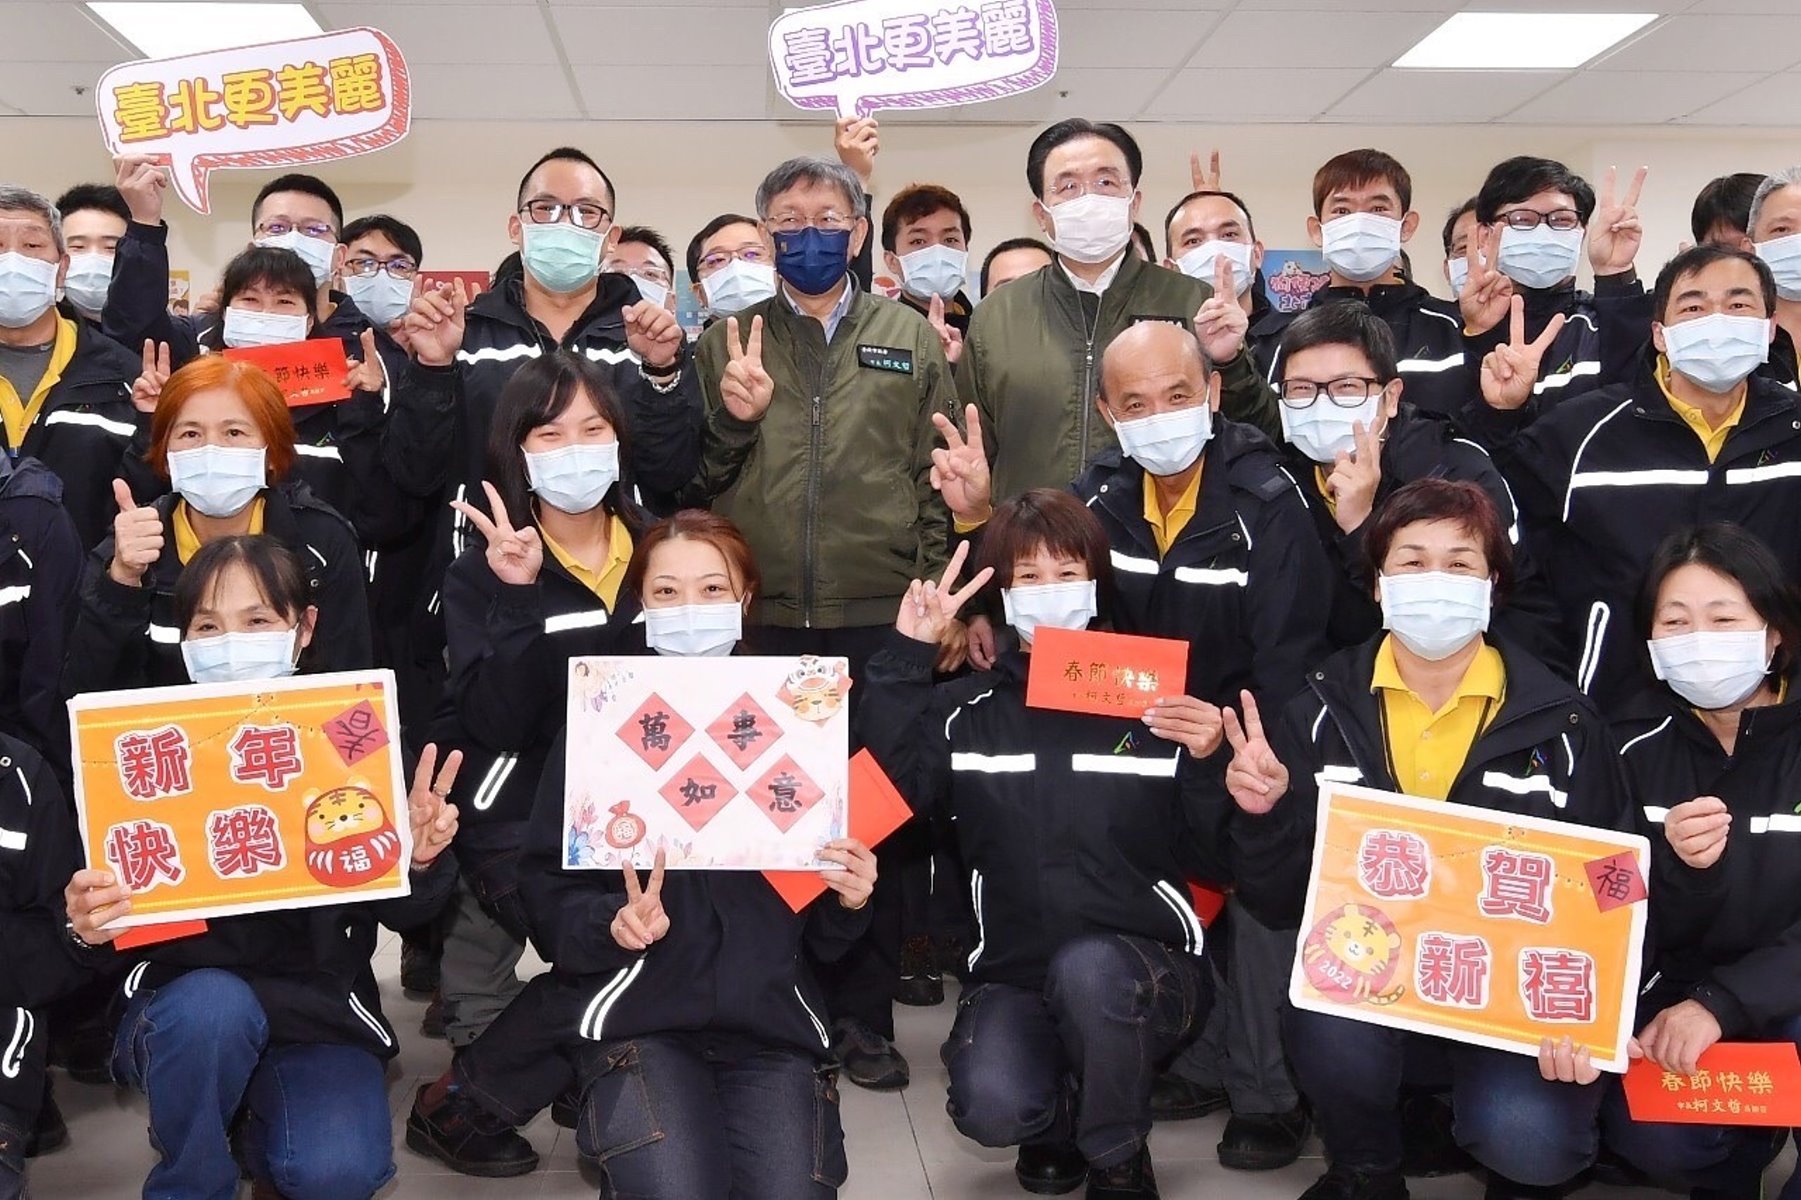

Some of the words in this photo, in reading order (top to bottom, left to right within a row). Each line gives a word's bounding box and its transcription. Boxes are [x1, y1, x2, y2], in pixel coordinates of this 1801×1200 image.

[784, 0, 1035, 87] 臺北更美麗
[113, 53, 386, 144] 臺北更美麗
[263, 362, 330, 383] 節快樂
[1064, 660, 1160, 692] 春節快樂
[638, 709, 762, 752] 萬事
[117, 724, 303, 799] 新年
[679, 772, 803, 813] 如意
[107, 805, 287, 892] 快樂
[339, 845, 372, 873] 福
[1360, 831, 1552, 924] 恭賀
[1596, 859, 1634, 902] 福
[1318, 960, 1353, 990] 2022
[1416, 934, 1594, 1021] 新禧
[1661, 1069, 1774, 1095] 春節快樂
